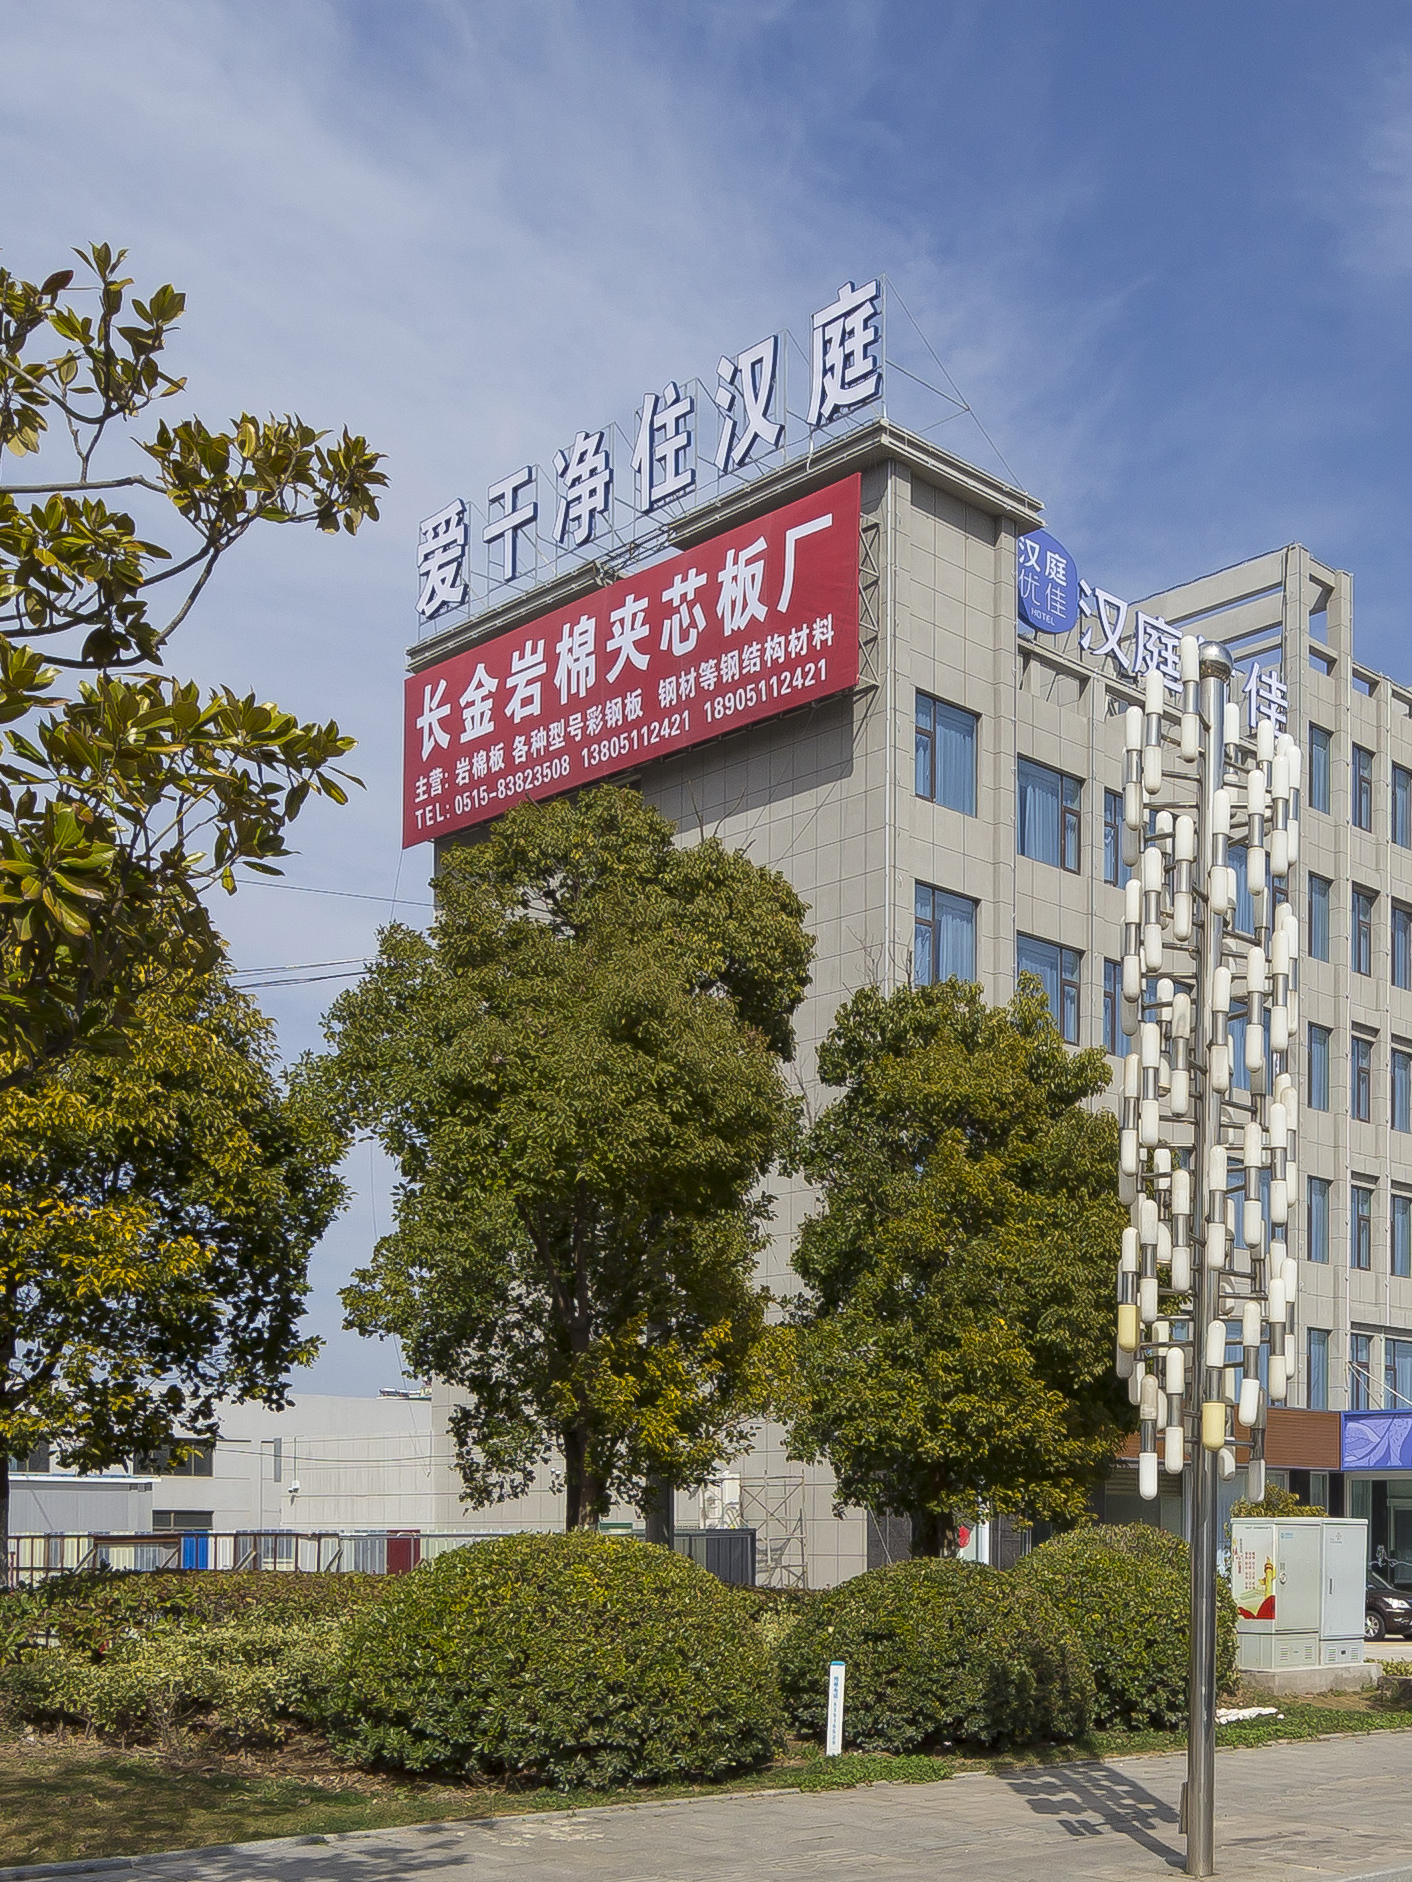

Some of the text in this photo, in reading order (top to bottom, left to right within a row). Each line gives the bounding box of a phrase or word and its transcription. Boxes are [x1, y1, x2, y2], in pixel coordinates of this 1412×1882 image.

[416, 278, 884, 620] 爱干净住汉庭
[1019, 536, 1067, 586] 汉庭
[1019, 568, 1067, 619] 优佳
[1030, 607, 1056, 626] HOTEL
[415, 512, 834, 763] 长金岩棉夹芯板厂
[511, 687, 644, 765] 各种型号彩钢板
[657, 612, 835, 709] 钢材等钢结构材料
[1078, 578, 1289, 738] 汉庭佳
[580, 709, 691, 768] 13805112421
[703, 658, 827, 723] 18905112421
